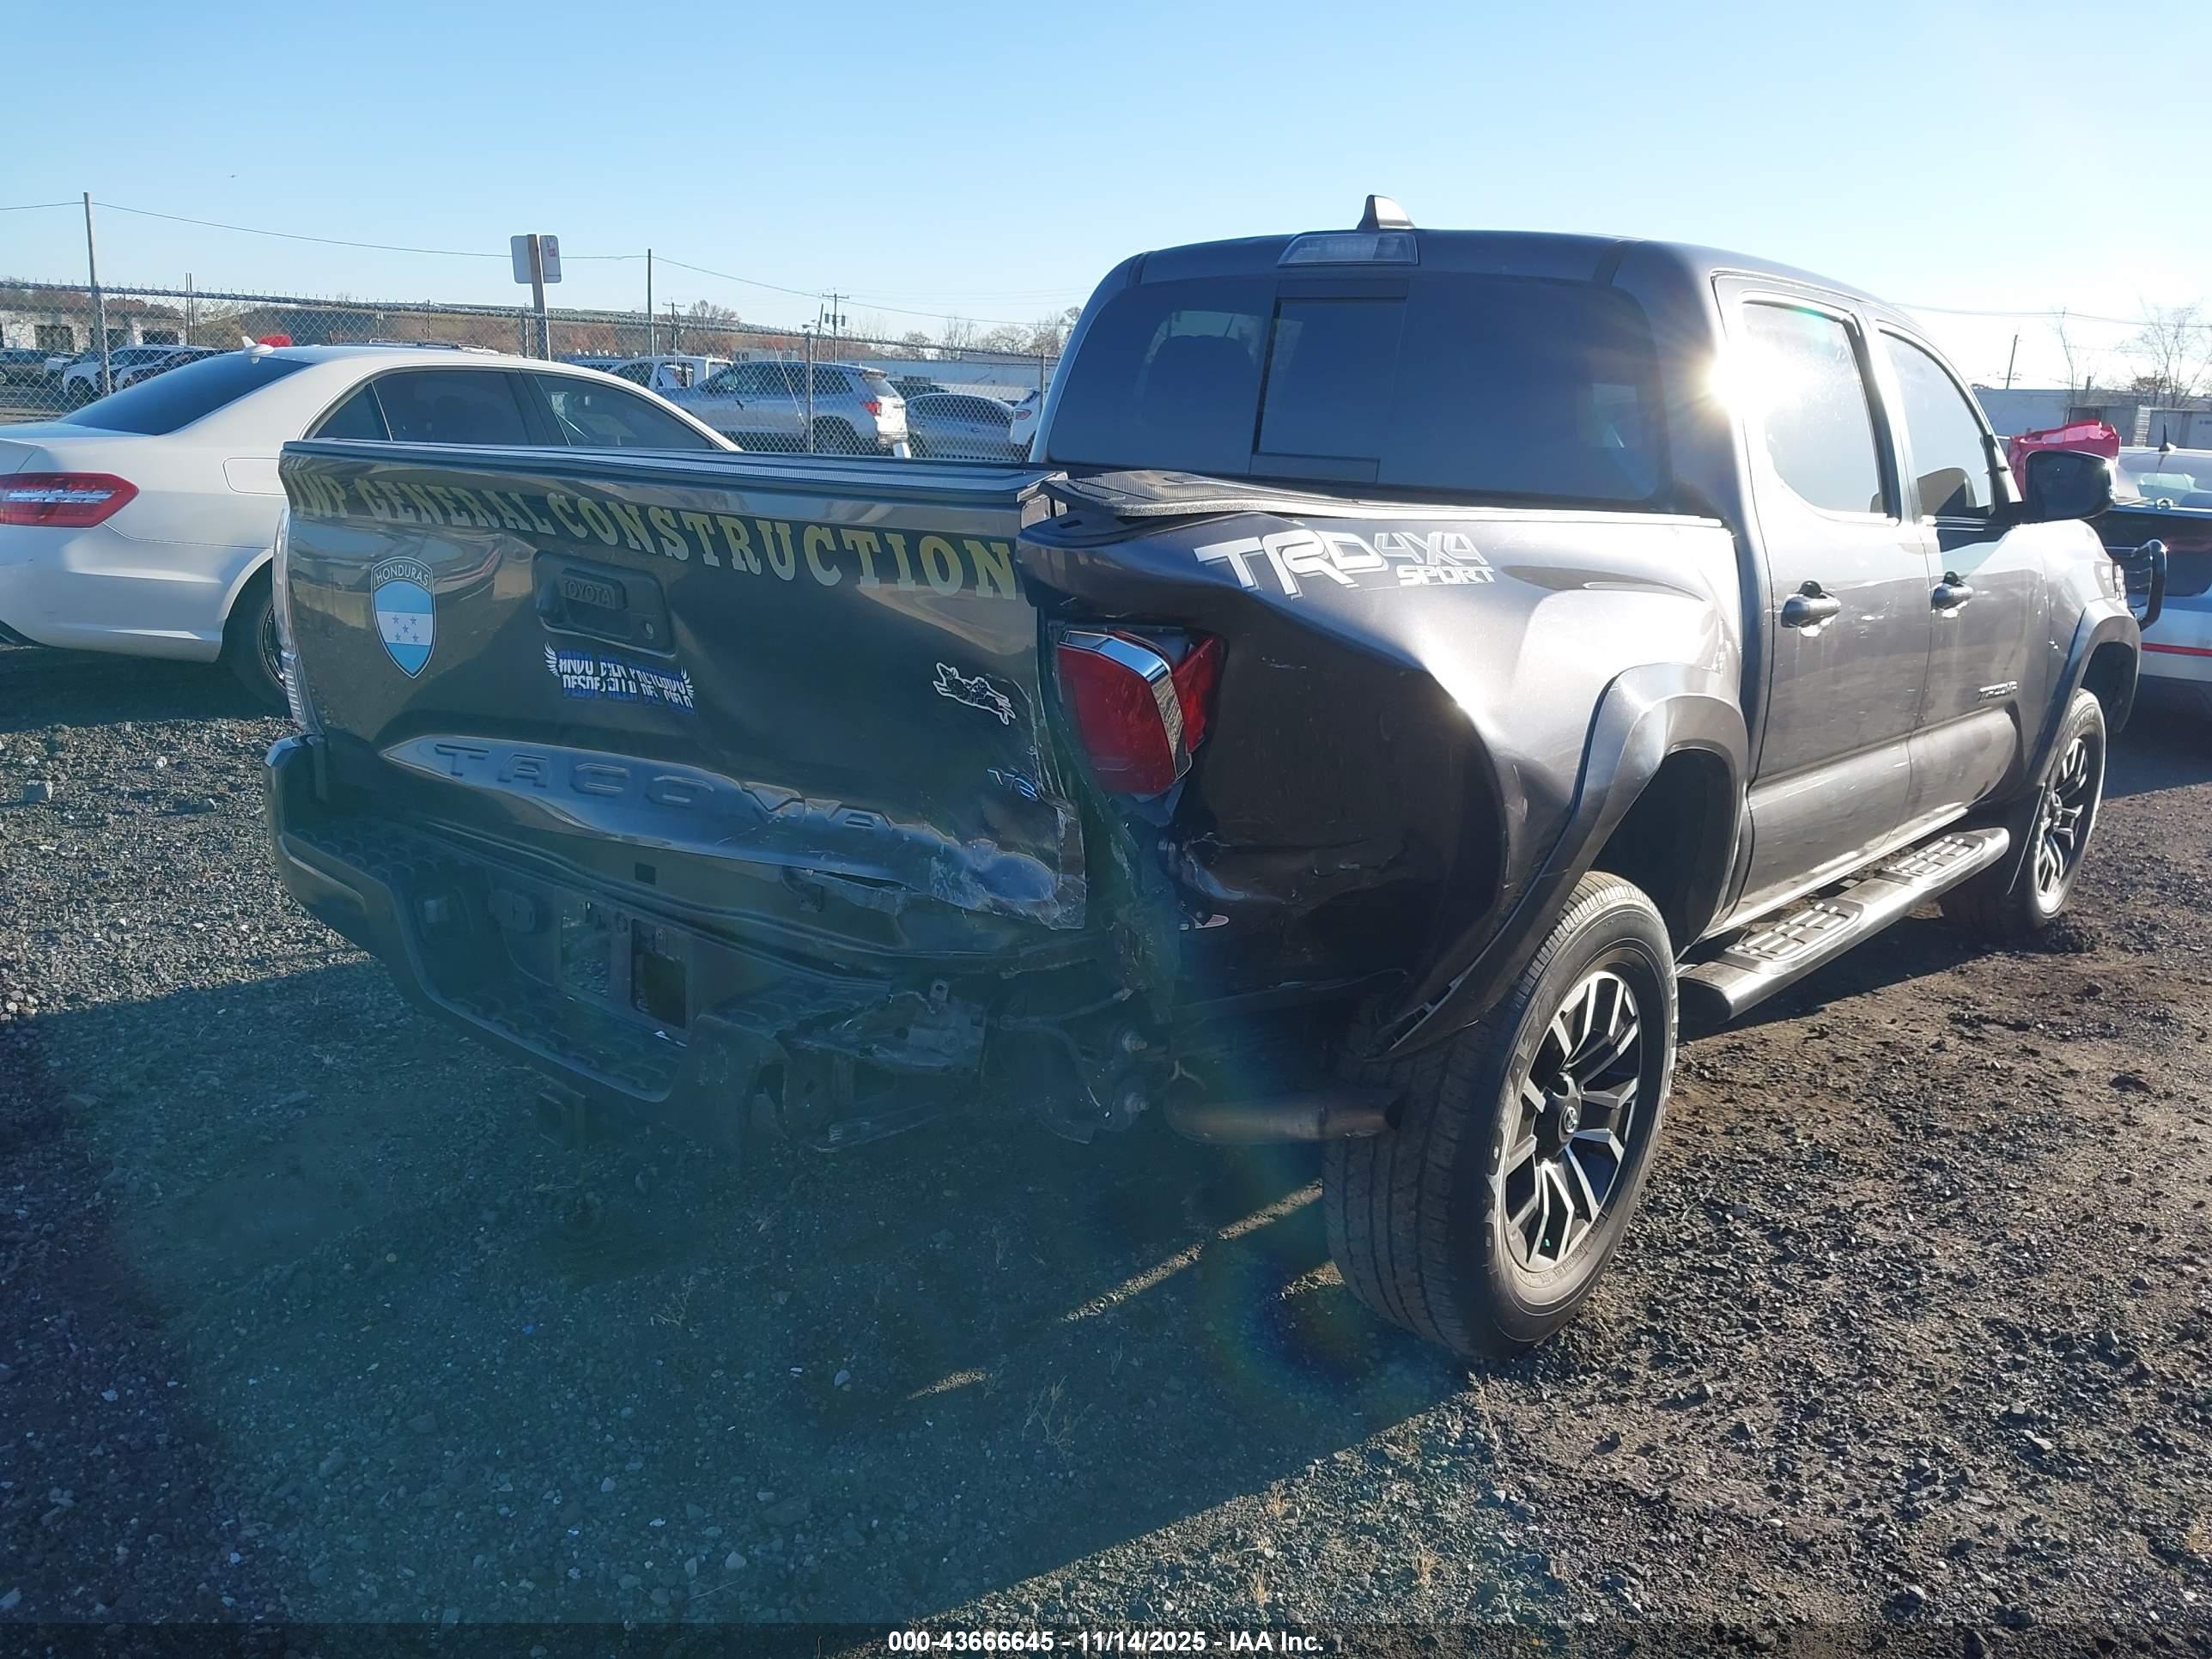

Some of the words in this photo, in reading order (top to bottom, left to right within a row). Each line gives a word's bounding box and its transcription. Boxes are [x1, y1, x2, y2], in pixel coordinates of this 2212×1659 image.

[355, 478, 557, 535] GENERAL
[547, 492, 1017, 600] CONSTRUCTION
[375, 565, 428, 586] HONDURAS
[1194, 529, 1389, 600] TRD
[1396, 564, 1496, 586] SPORT
[563, 580, 615, 606] TOYOTA
